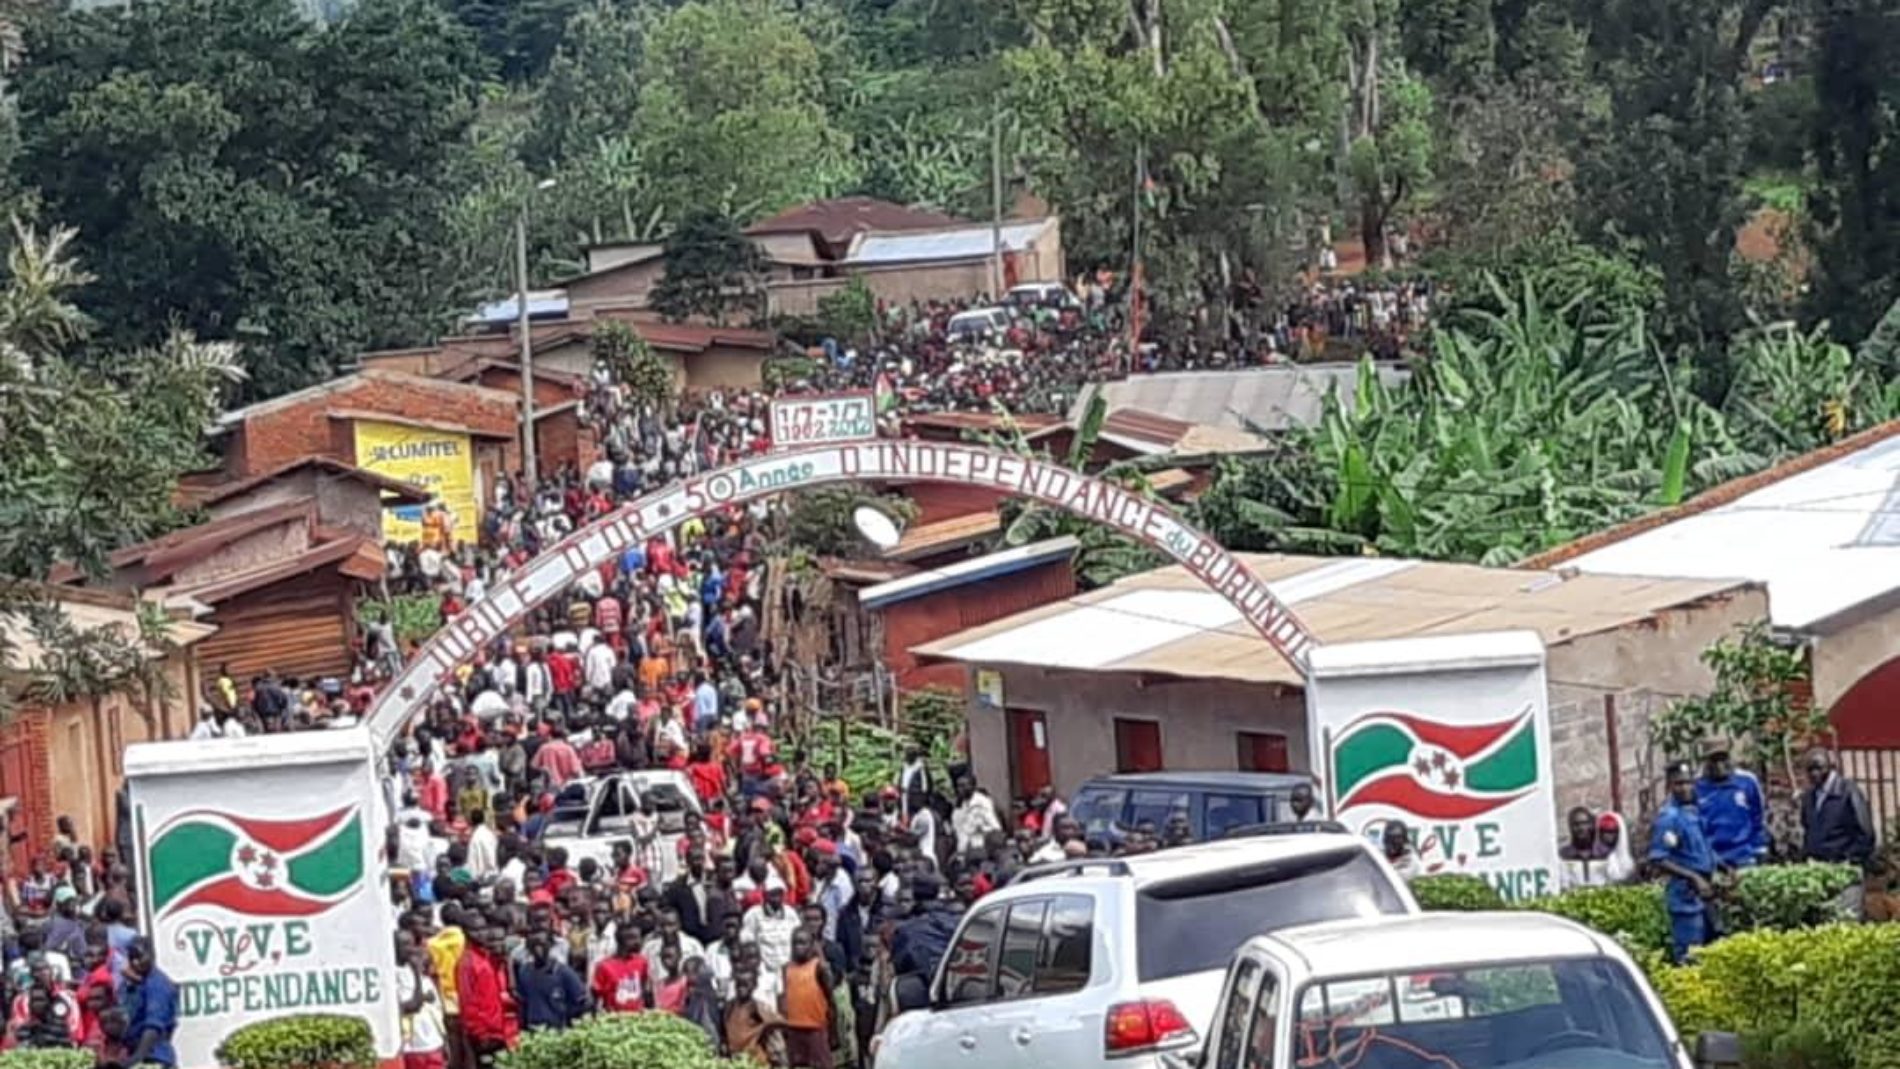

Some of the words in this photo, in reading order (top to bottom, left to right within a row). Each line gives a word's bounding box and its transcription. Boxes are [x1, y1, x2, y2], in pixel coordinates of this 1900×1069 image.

[1165, 530, 1194, 556] du
[1190, 537, 1307, 656] BURUNDI
[185, 920, 312, 965] VIVE
[176, 967, 381, 1018] DEPENDANCE
